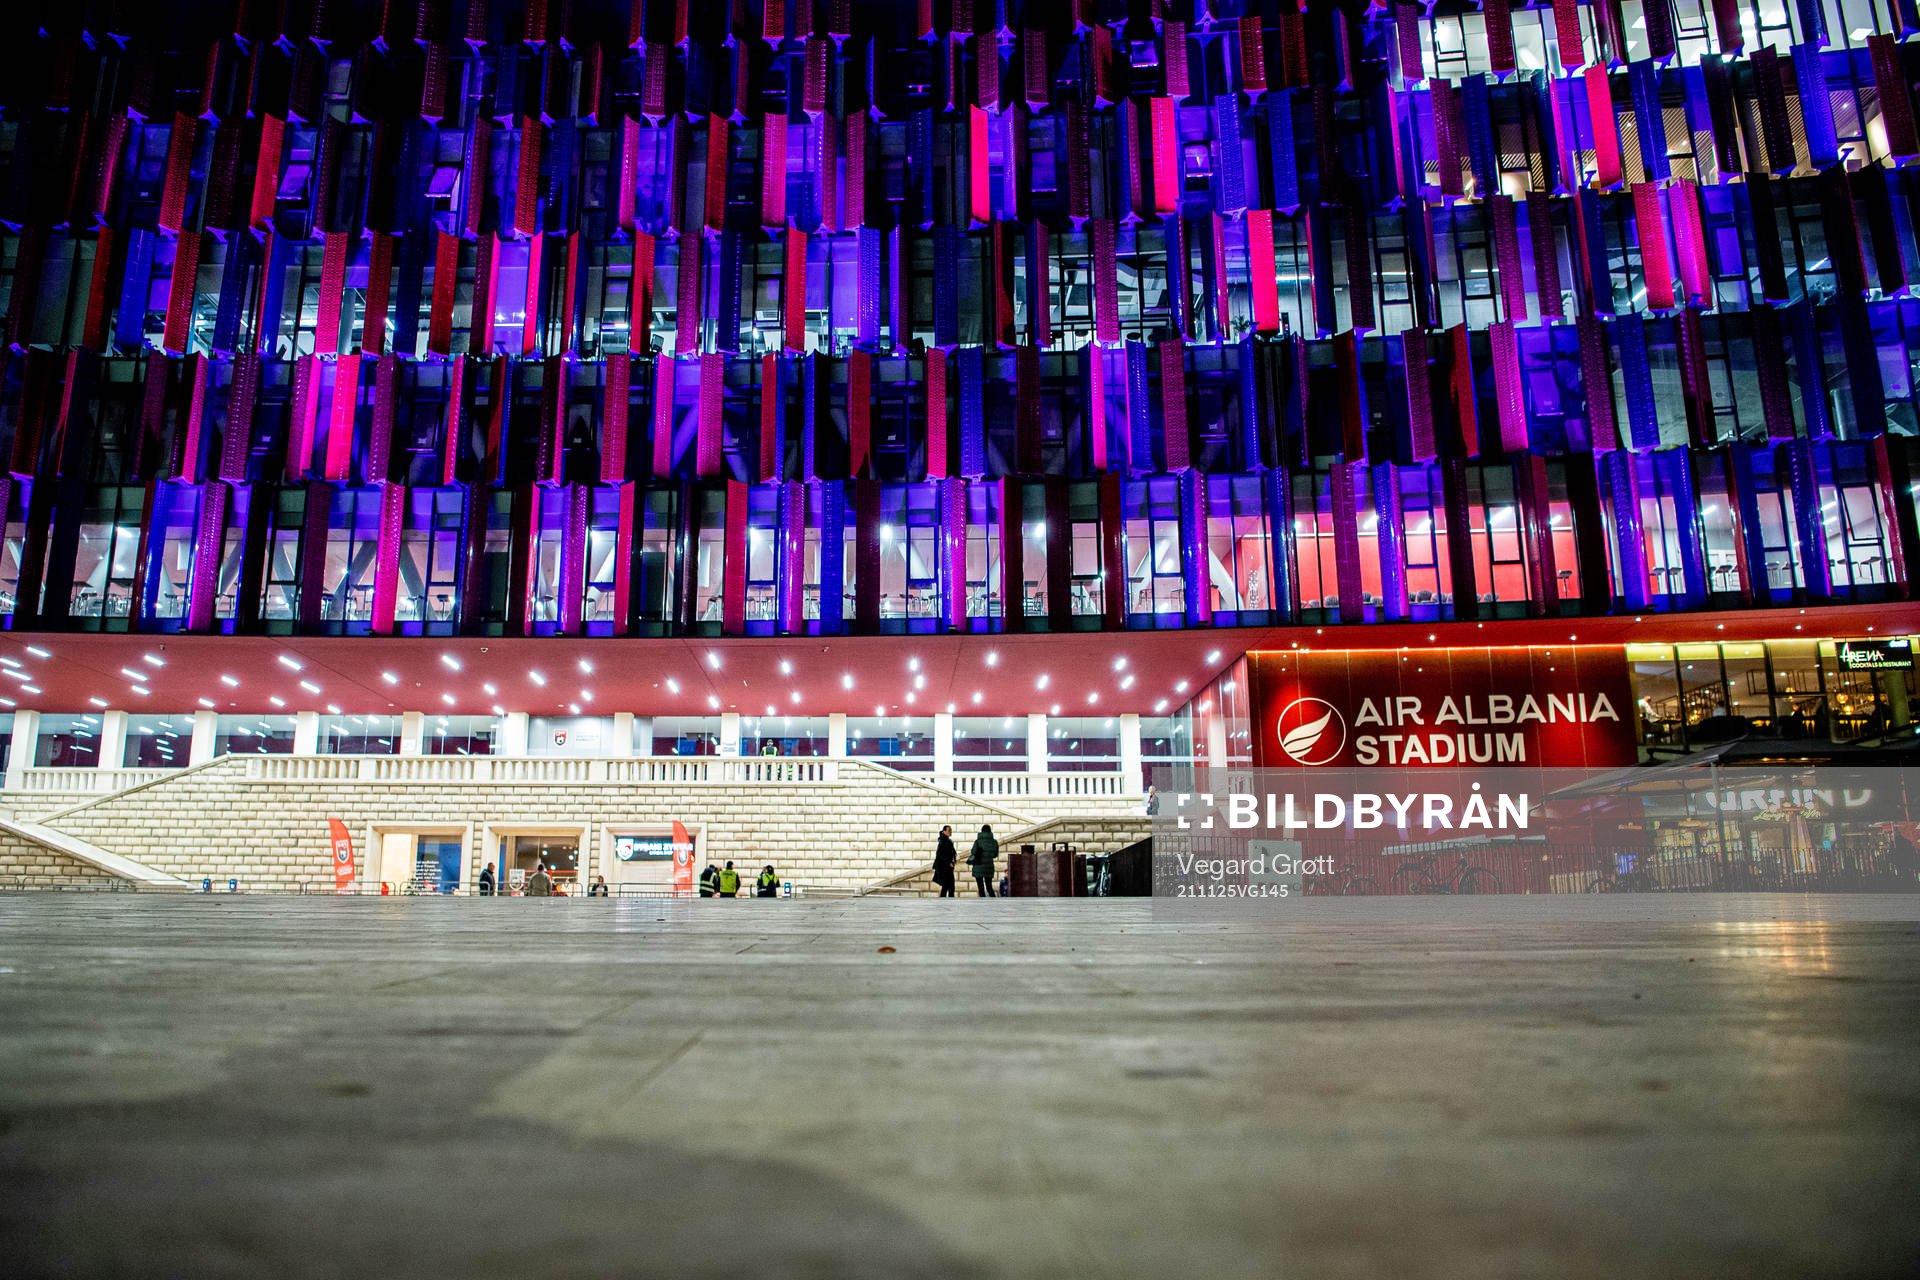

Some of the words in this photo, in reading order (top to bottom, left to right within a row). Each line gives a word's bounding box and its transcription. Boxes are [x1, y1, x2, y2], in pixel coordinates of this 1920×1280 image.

[1840, 642, 1884, 665] ARENA
[1355, 696, 1425, 727] AIR
[1434, 692, 1620, 725] ALBANIA
[1355, 732, 1526, 765] STADIUM
